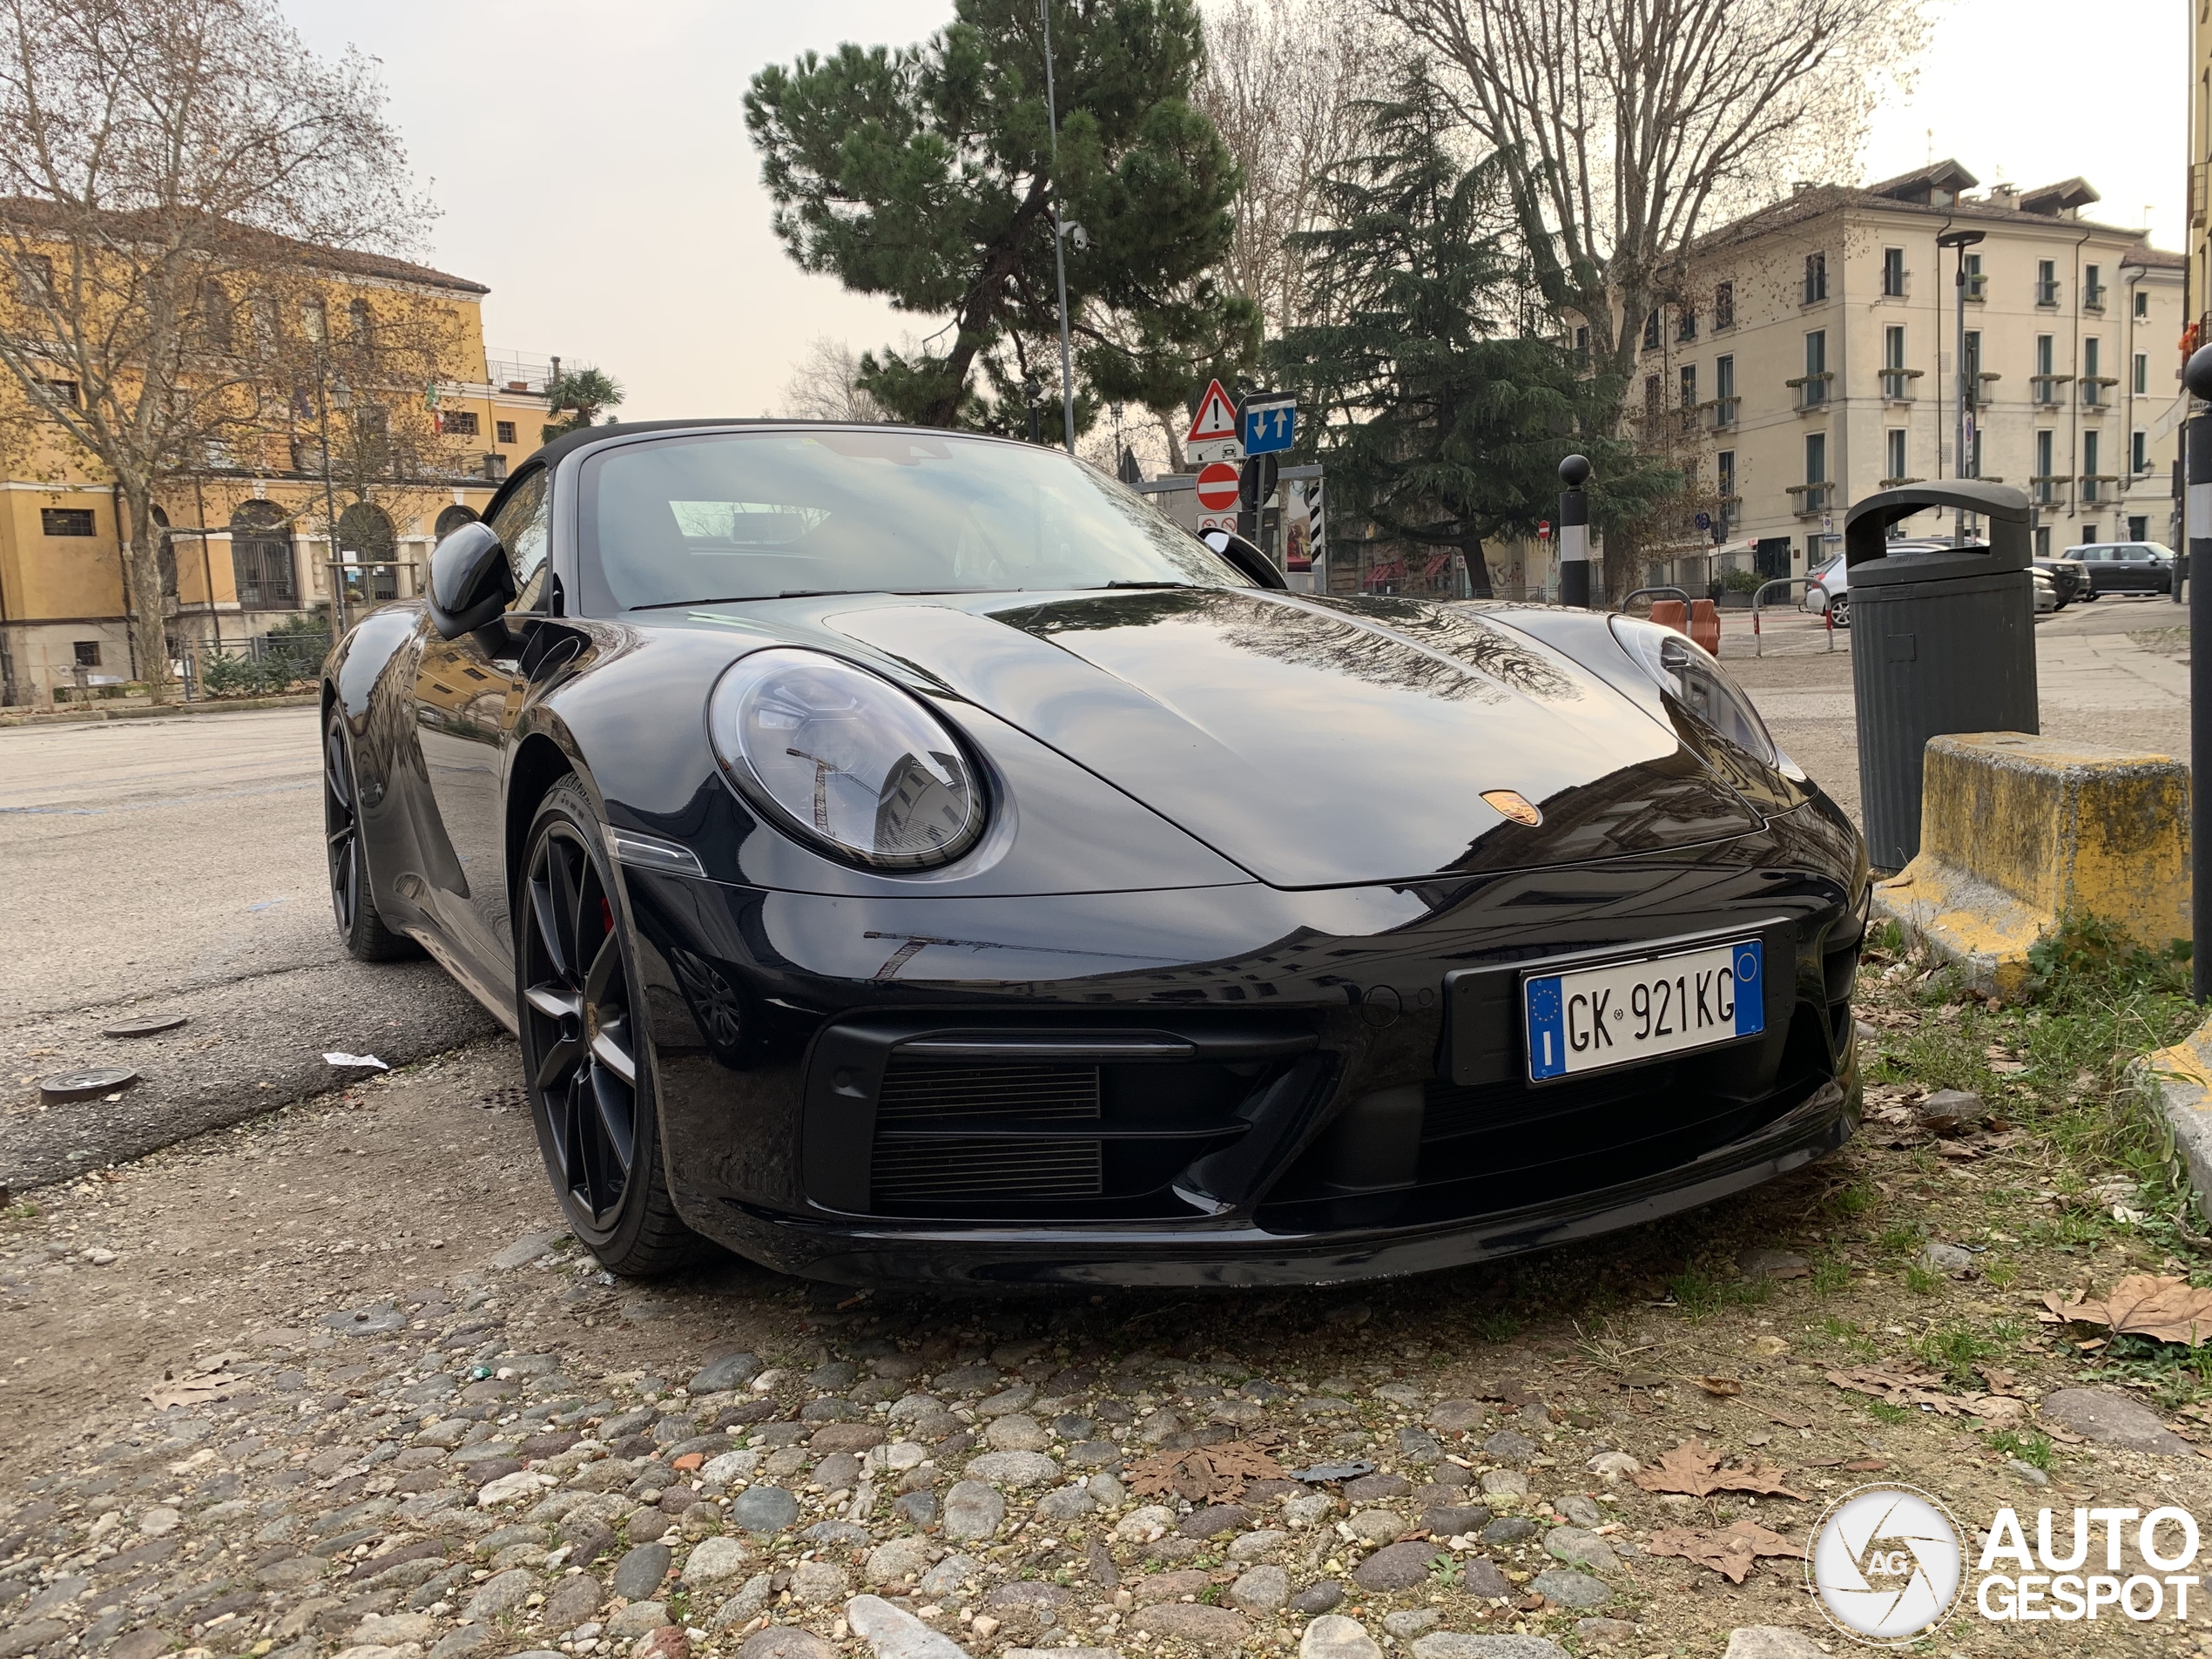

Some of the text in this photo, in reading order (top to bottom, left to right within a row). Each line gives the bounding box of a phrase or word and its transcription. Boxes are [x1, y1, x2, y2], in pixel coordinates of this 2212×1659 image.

[1568, 967, 1735, 1052] GK 921KG
[1543, 1031, 1552, 1066] I
